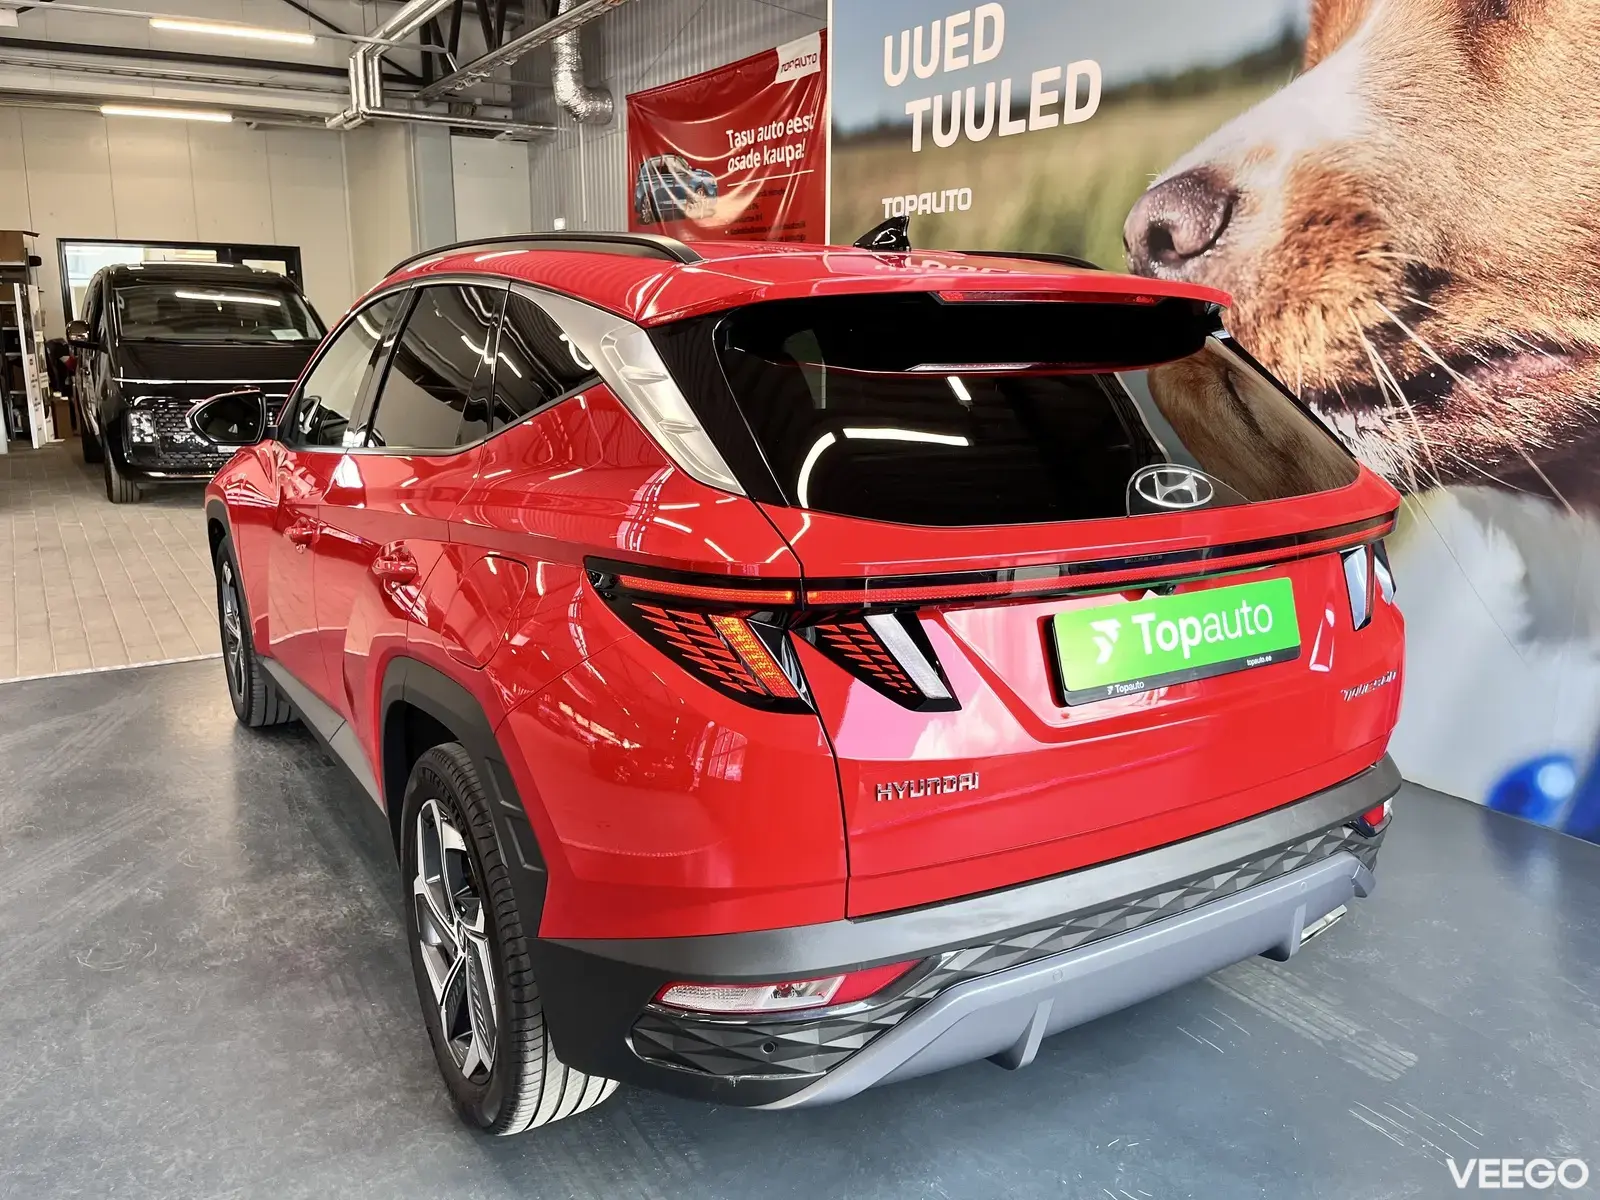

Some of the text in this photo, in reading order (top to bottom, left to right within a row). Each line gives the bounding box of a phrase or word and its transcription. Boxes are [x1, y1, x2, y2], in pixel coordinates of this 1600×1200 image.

[884, 2, 1005, 87] UUED
[780, 52, 818, 73] TOPAUTO
[905, 59, 1102, 152] TUULED
[726, 111, 814, 149] Tasu auto eest
[727, 137, 806, 172] osade kaupa!
[881, 187, 972, 218] TOPAUTO
[1131, 599, 1273, 659] Topauto
[1115, 681, 1145, 694] Topauto
[876, 772, 979, 802] HYUNDAI
